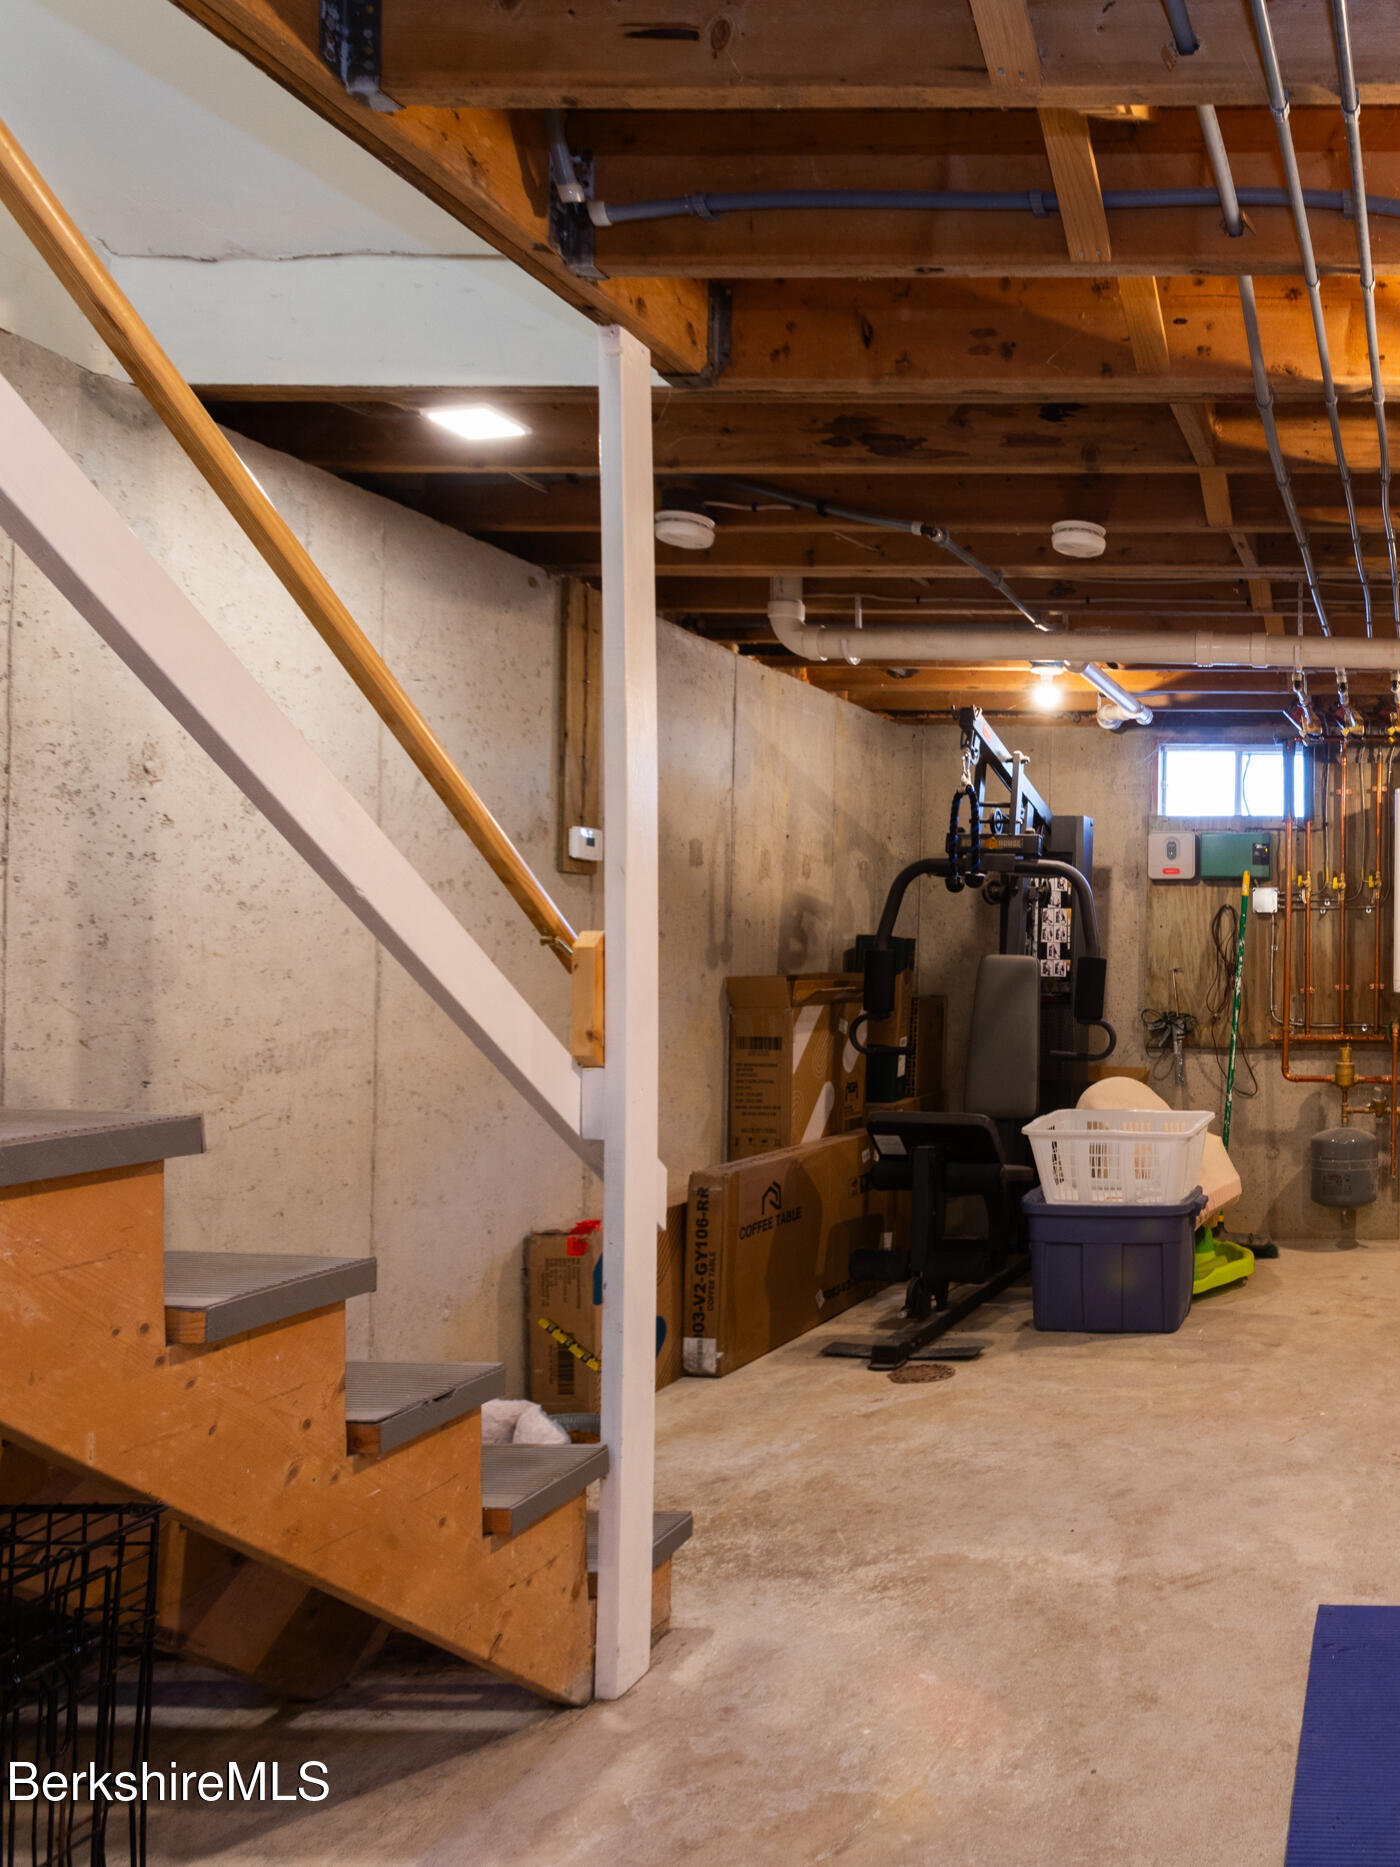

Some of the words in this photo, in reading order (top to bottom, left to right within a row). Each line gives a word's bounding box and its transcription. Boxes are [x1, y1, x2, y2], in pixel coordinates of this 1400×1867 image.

[738, 1216, 774, 1240] COFFEE
[776, 1206, 803, 1228] TABLE
[692, 1186, 710, 1338] 03-V2-GY106-RR
[708, 1252, 717, 1277] TABLE
[707, 1280, 716, 1312] COFFEE
